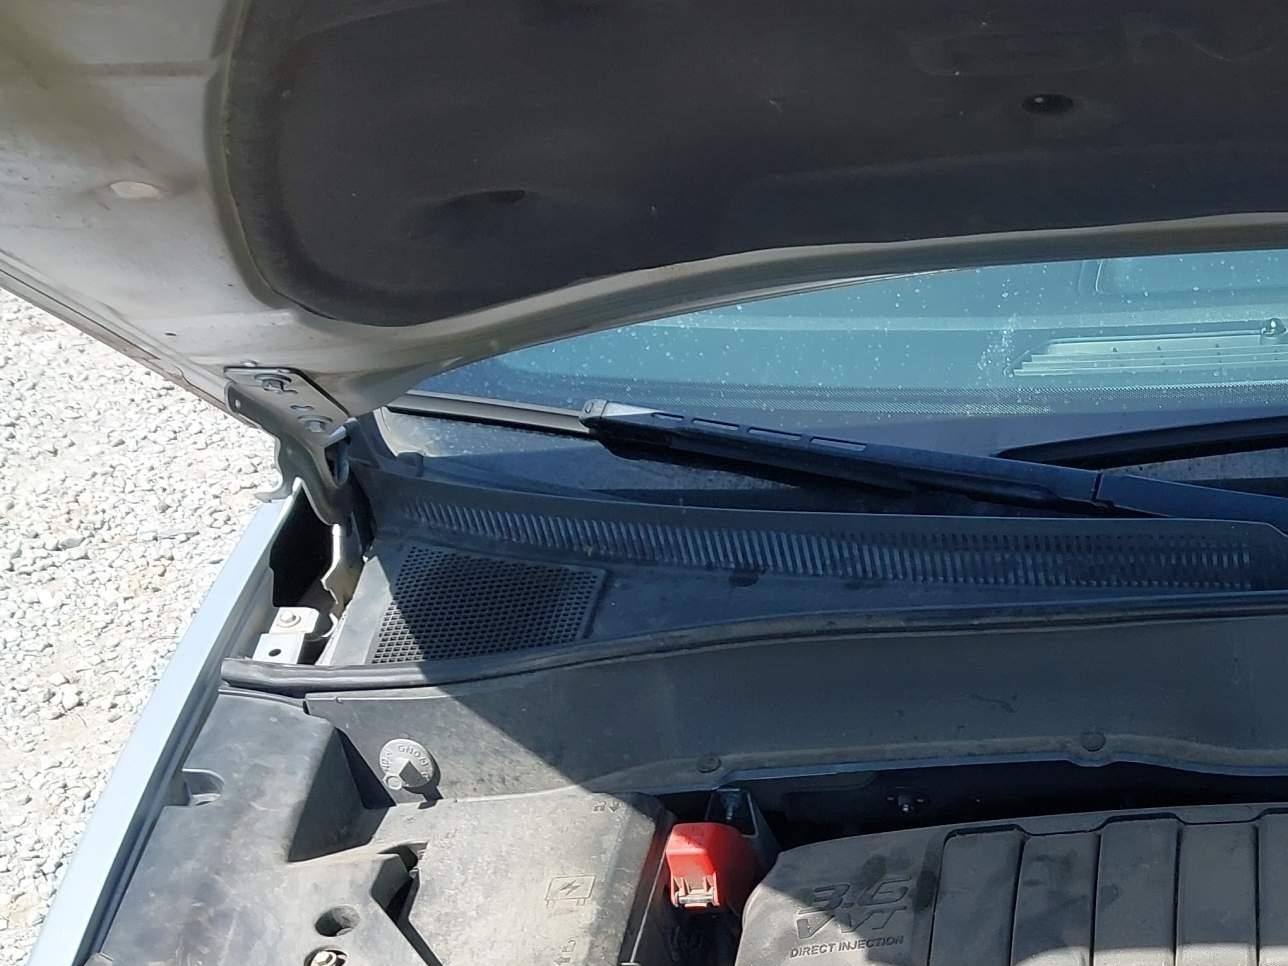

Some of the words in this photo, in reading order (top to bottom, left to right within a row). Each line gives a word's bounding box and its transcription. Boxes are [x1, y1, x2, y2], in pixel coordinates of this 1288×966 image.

[796, 876, 913, 915] 3.6
[795, 904, 908, 940] VVT
[789, 942, 837, 959] DIRECT
[837, 934, 905, 953] INJECTION
